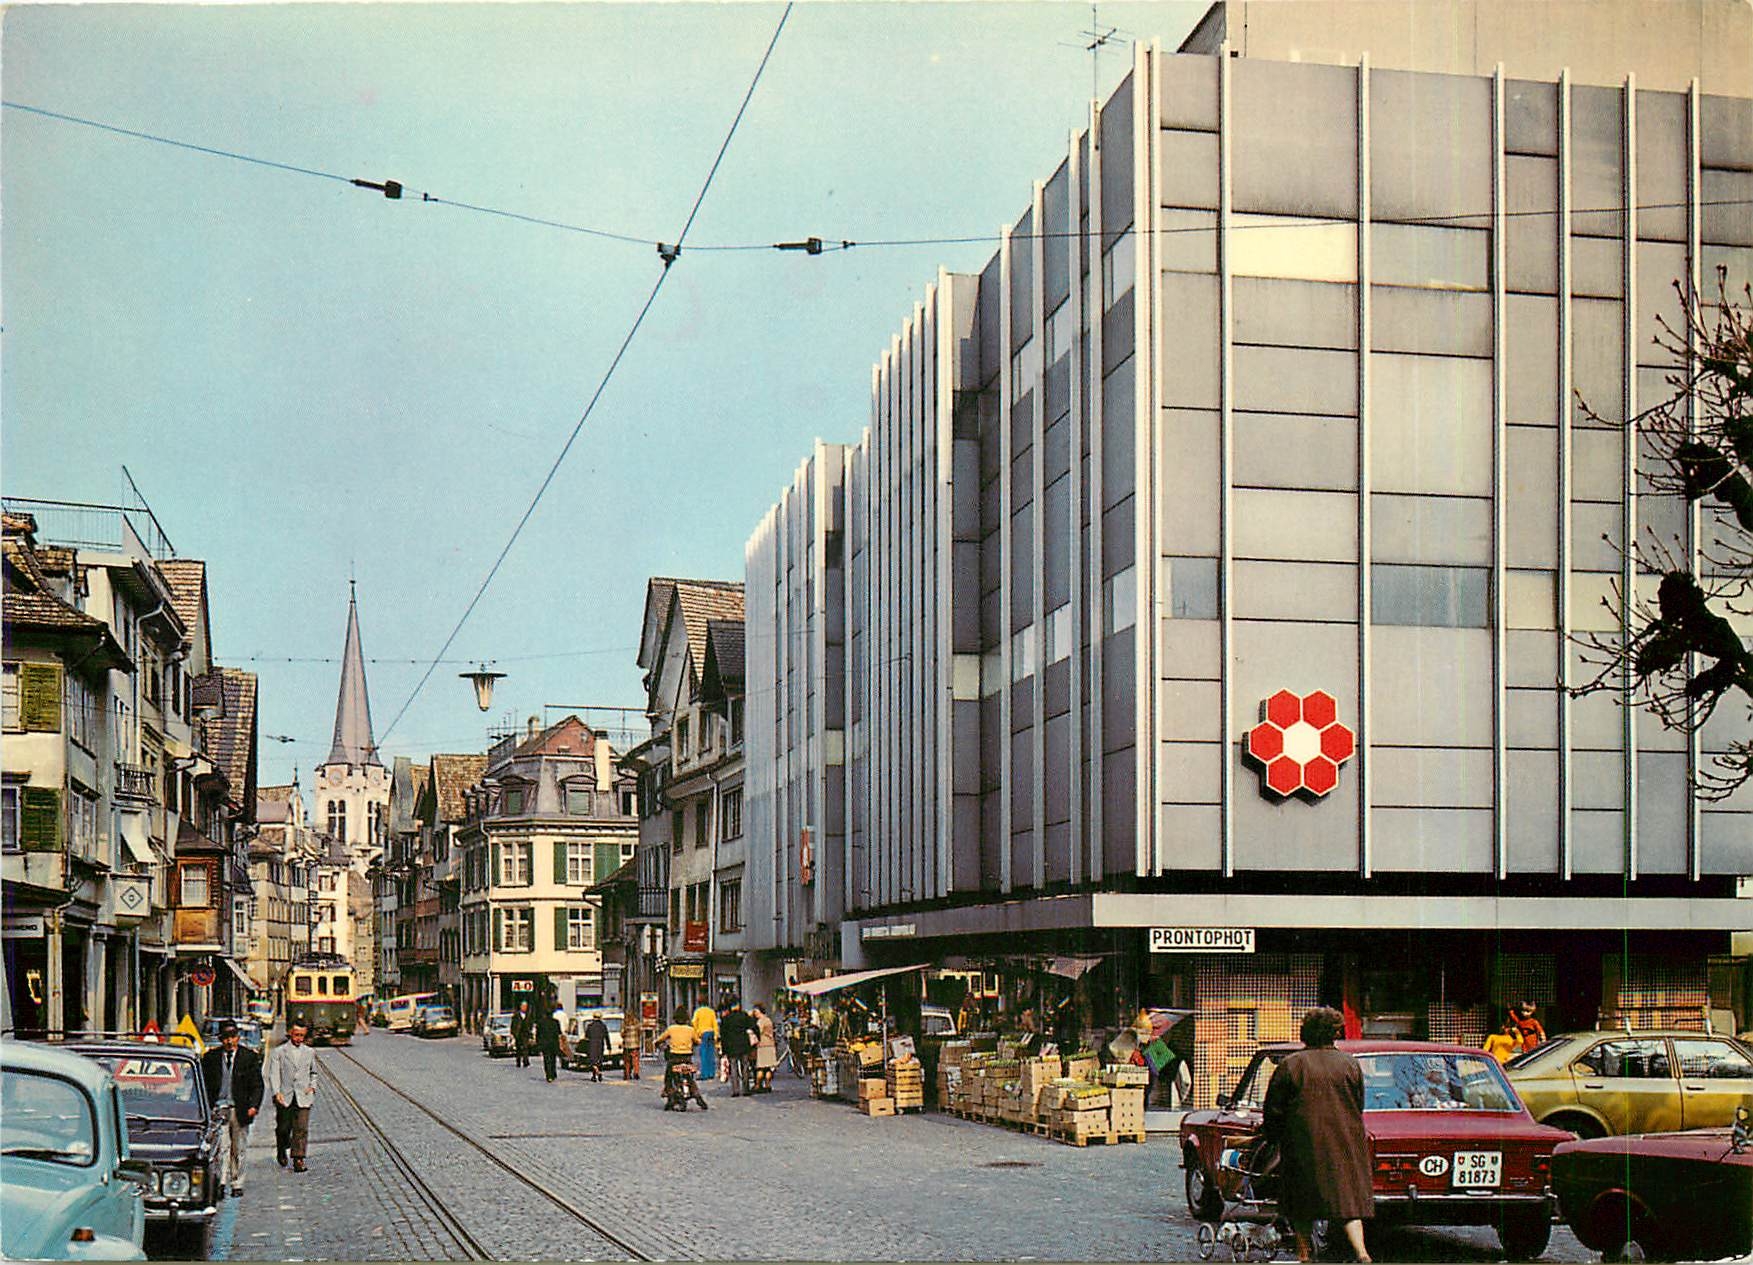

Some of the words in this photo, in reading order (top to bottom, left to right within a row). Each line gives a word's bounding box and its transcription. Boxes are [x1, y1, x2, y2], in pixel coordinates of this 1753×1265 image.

[1153, 930, 1252, 945] PRONTOPHOT
[1424, 1159, 1443, 1173] CH
[1470, 1154, 1486, 1168] SG
[1458, 1170, 1496, 1184] 81873
